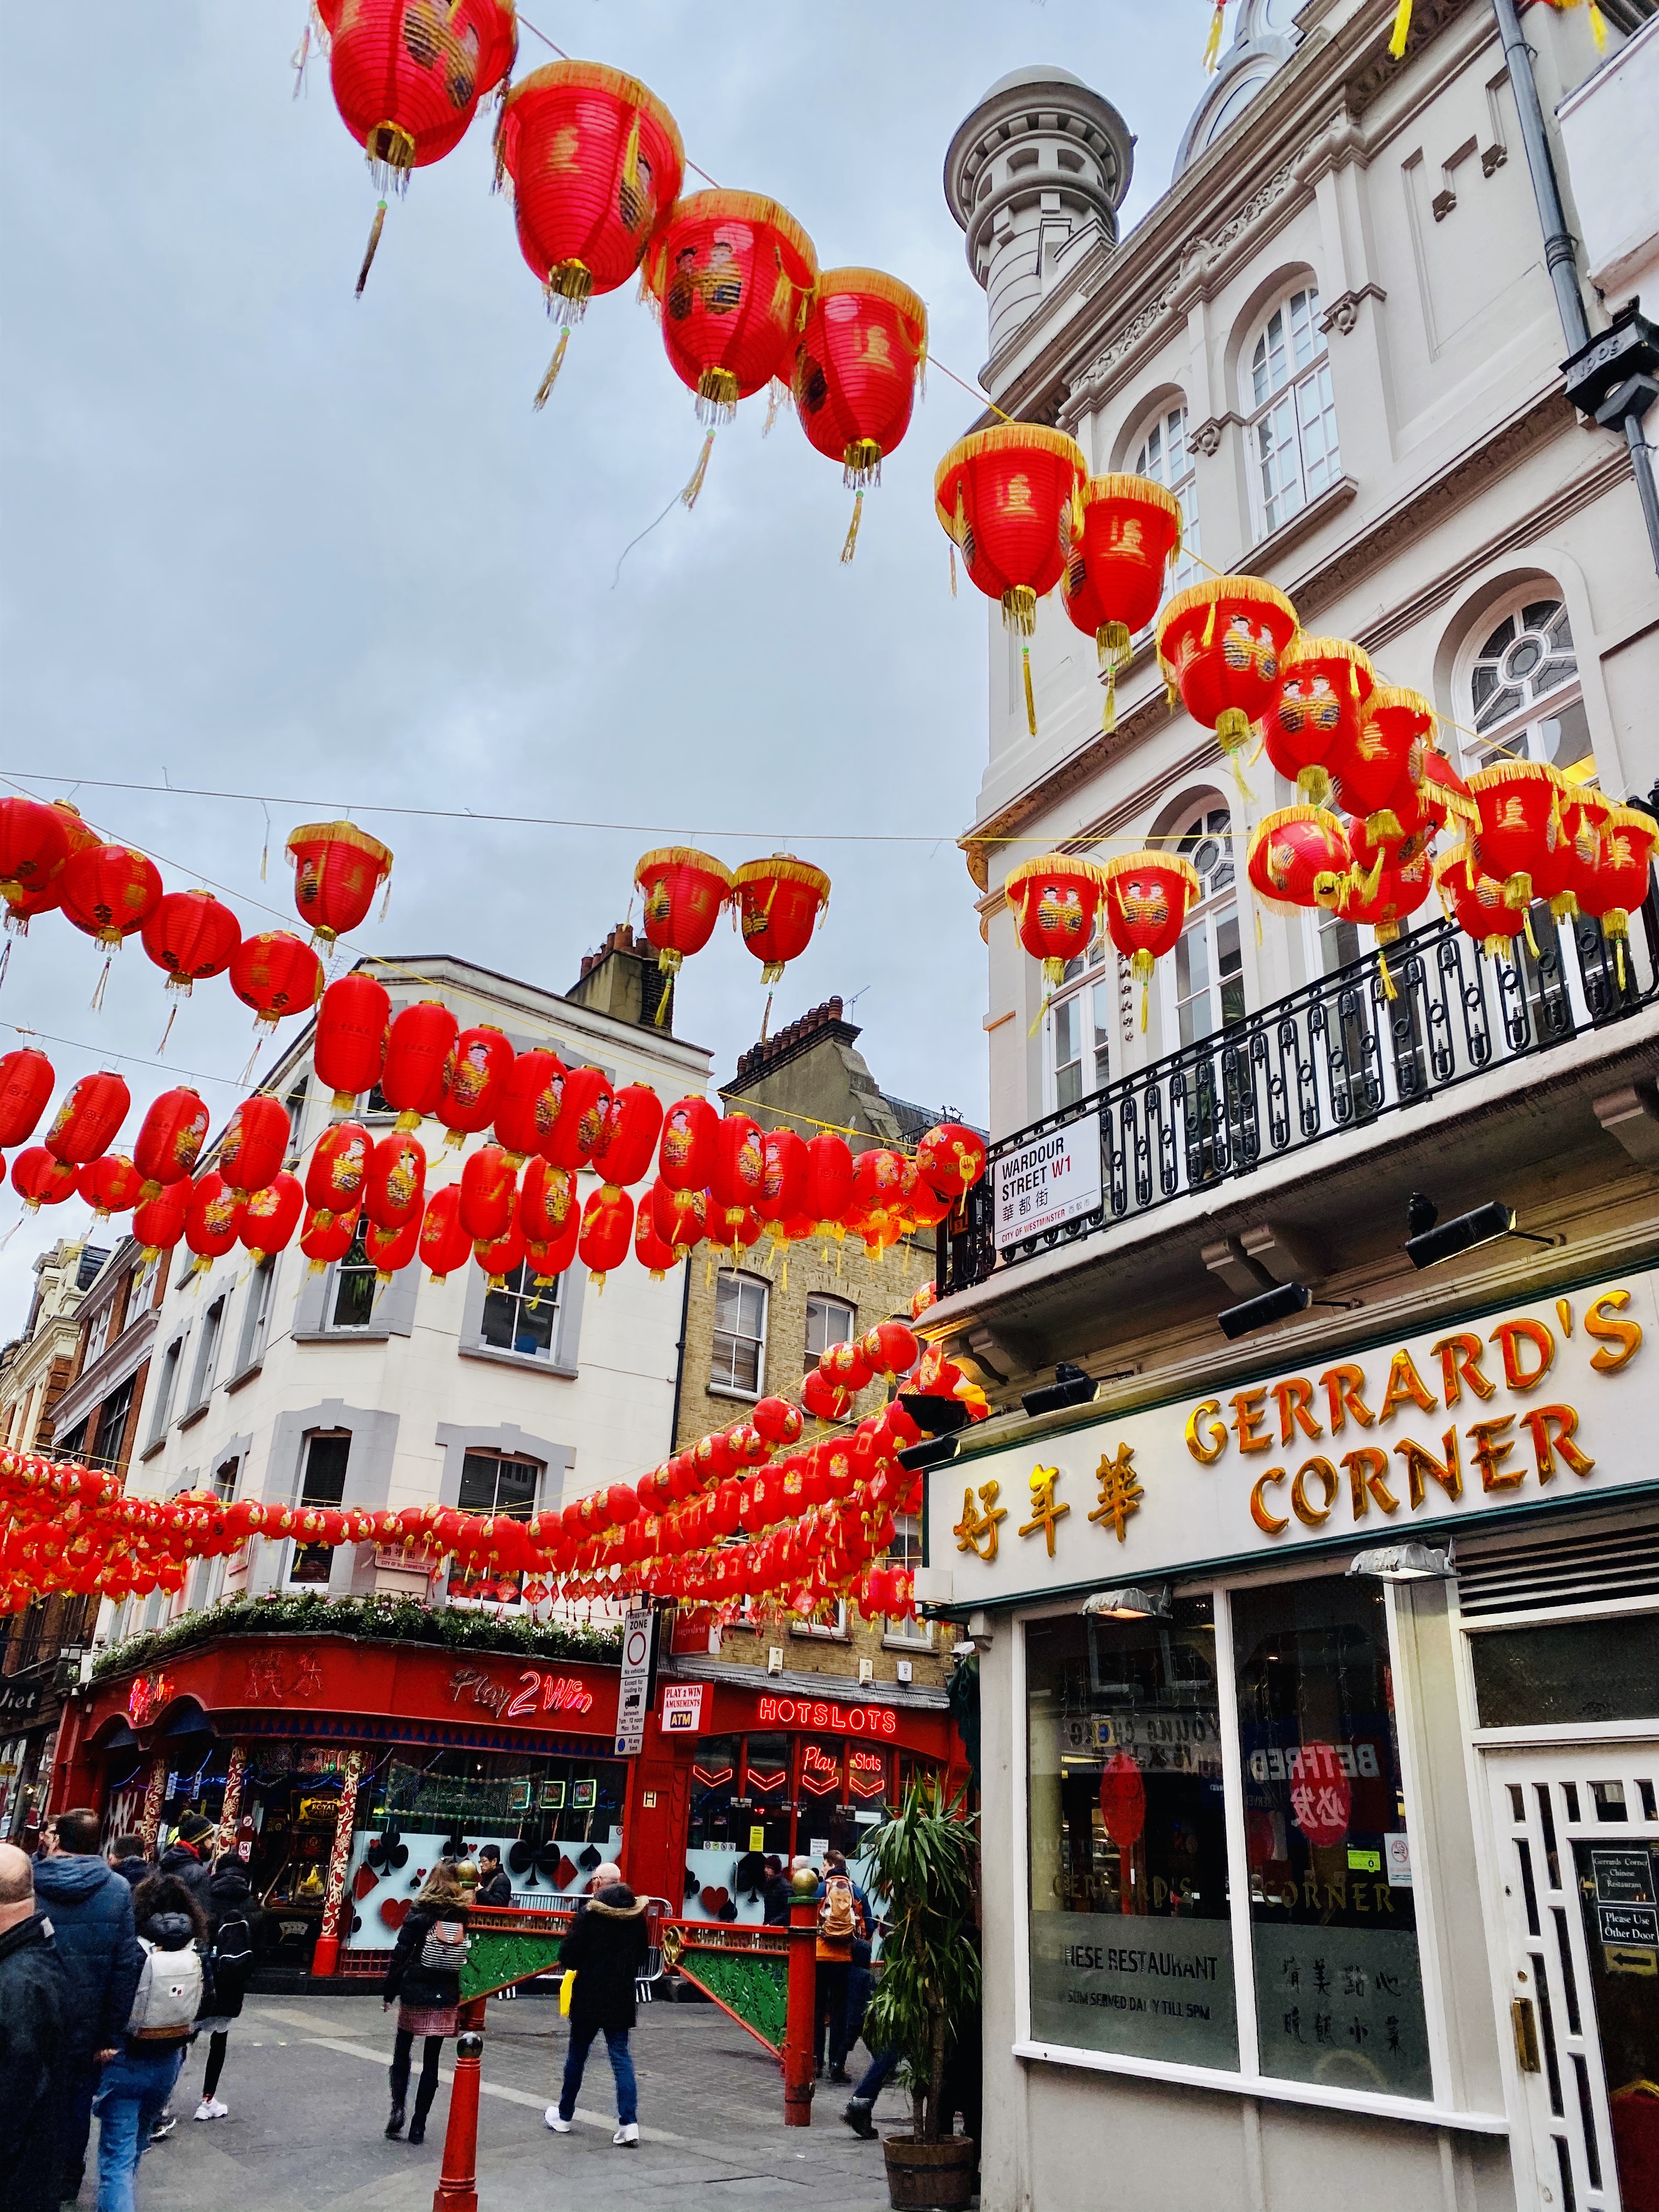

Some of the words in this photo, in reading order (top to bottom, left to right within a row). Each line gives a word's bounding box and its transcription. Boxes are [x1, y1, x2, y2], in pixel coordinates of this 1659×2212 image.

[1002, 1137, 1064, 1180] WARDOUR
[1002, 1166, 1047, 1201] STREET
[1052, 1155, 1071, 1178] W1
[1002, 1188, 1048, 1222] 華都街
[1002, 1232, 1014, 1243] CITY
[1015, 1228, 1023, 1237] OF
[1024, 1209, 1065, 1233] WESTMINSTER
[1186, 1289, 1643, 1464] GERRARD'S
[1250, 1403, 1595, 1534] CORNER
[953, 1441, 1144, 1560] 好年華
[630, 1620, 648, 1630] ZONE
[448, 1668, 512, 1719] Play
[508, 1671, 541, 1717] 2
[543, 1675, 592, 1713] Win
[665, 1699, 700, 1708] AMUSEMENTS
[666, 1688, 682, 1698] PLAY
[688, 1686, 701, 1697] WIN
[671, 1713, 691, 1725] ATM
[760, 1699, 896, 1733] HOTSLOTS
[804, 1746, 837, 1776] Play
[855, 1752, 882, 1771] Slots
[1607, 1879, 1641, 1888] Restaurant
[1610, 1869, 1635, 1877] Chinese
[1263, 1881, 1395, 1912] CORNER
[1605, 1927, 1630, 1938] Other
[1632, 1928, 1655, 1940] Door
[1606, 1912, 1632, 1923] Please
[1633, 1914, 1650, 1925] Use
[1090, 1992, 1127, 2010] SERVED
[1163, 2000, 1184, 2017] TILL
